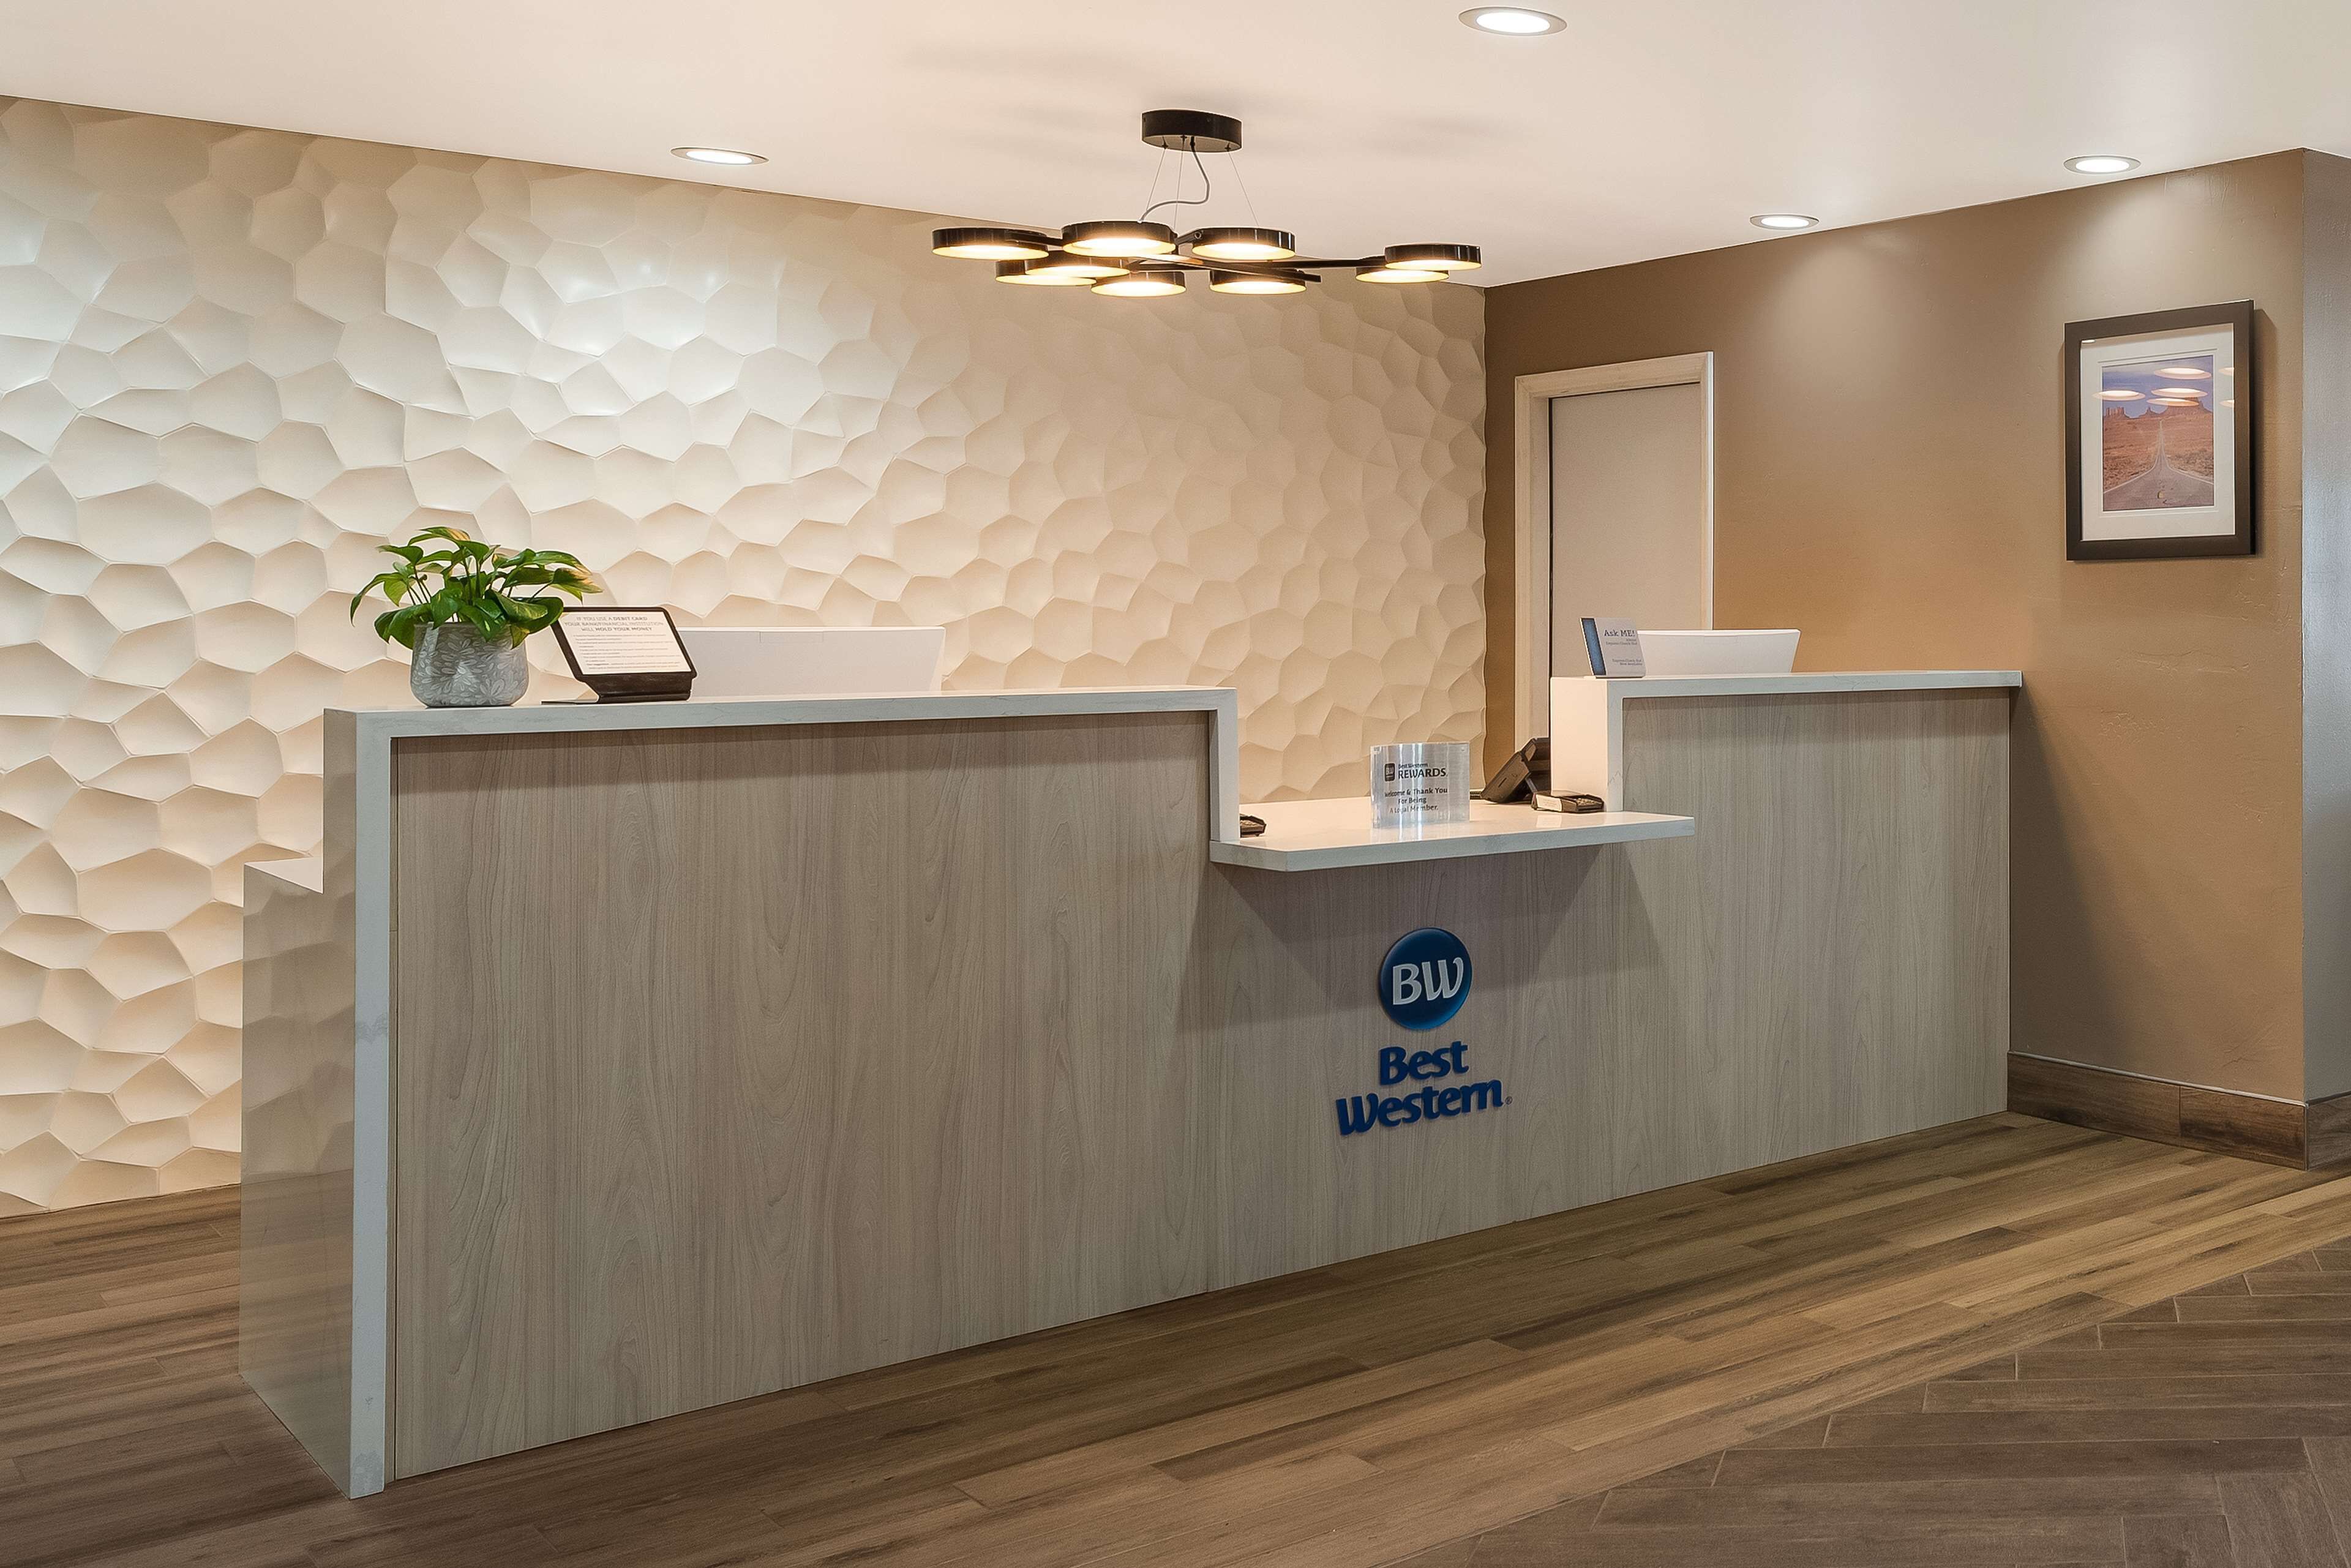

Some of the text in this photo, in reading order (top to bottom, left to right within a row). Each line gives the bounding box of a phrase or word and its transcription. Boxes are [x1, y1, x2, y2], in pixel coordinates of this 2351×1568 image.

[1398, 768, 1446, 779] REWARDS
[1392, 956, 1464, 1005] BW
[1379, 1040, 1469, 1086] Best
[1335, 1078, 1504, 1136] Western
